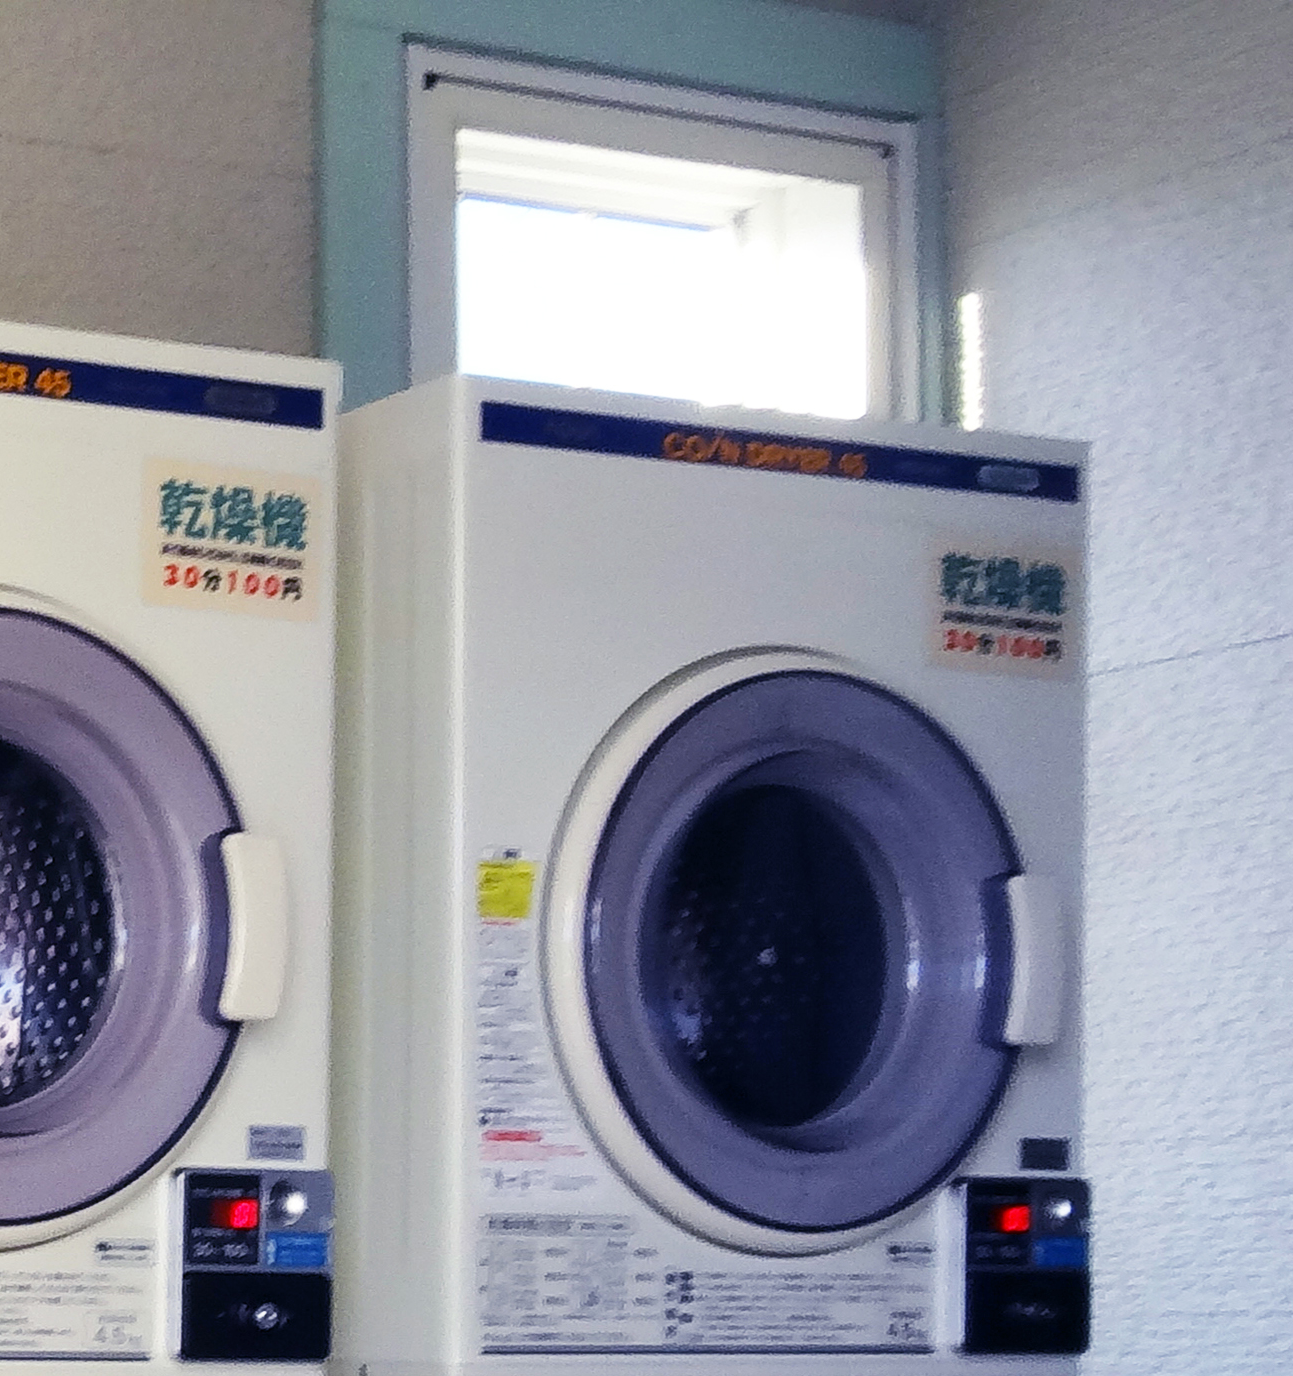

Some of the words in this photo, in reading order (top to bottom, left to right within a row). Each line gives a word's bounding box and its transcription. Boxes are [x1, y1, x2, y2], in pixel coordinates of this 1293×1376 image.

[158, 477, 309, 551] 乾燥機
[163, 562, 304, 602] 30分100円
